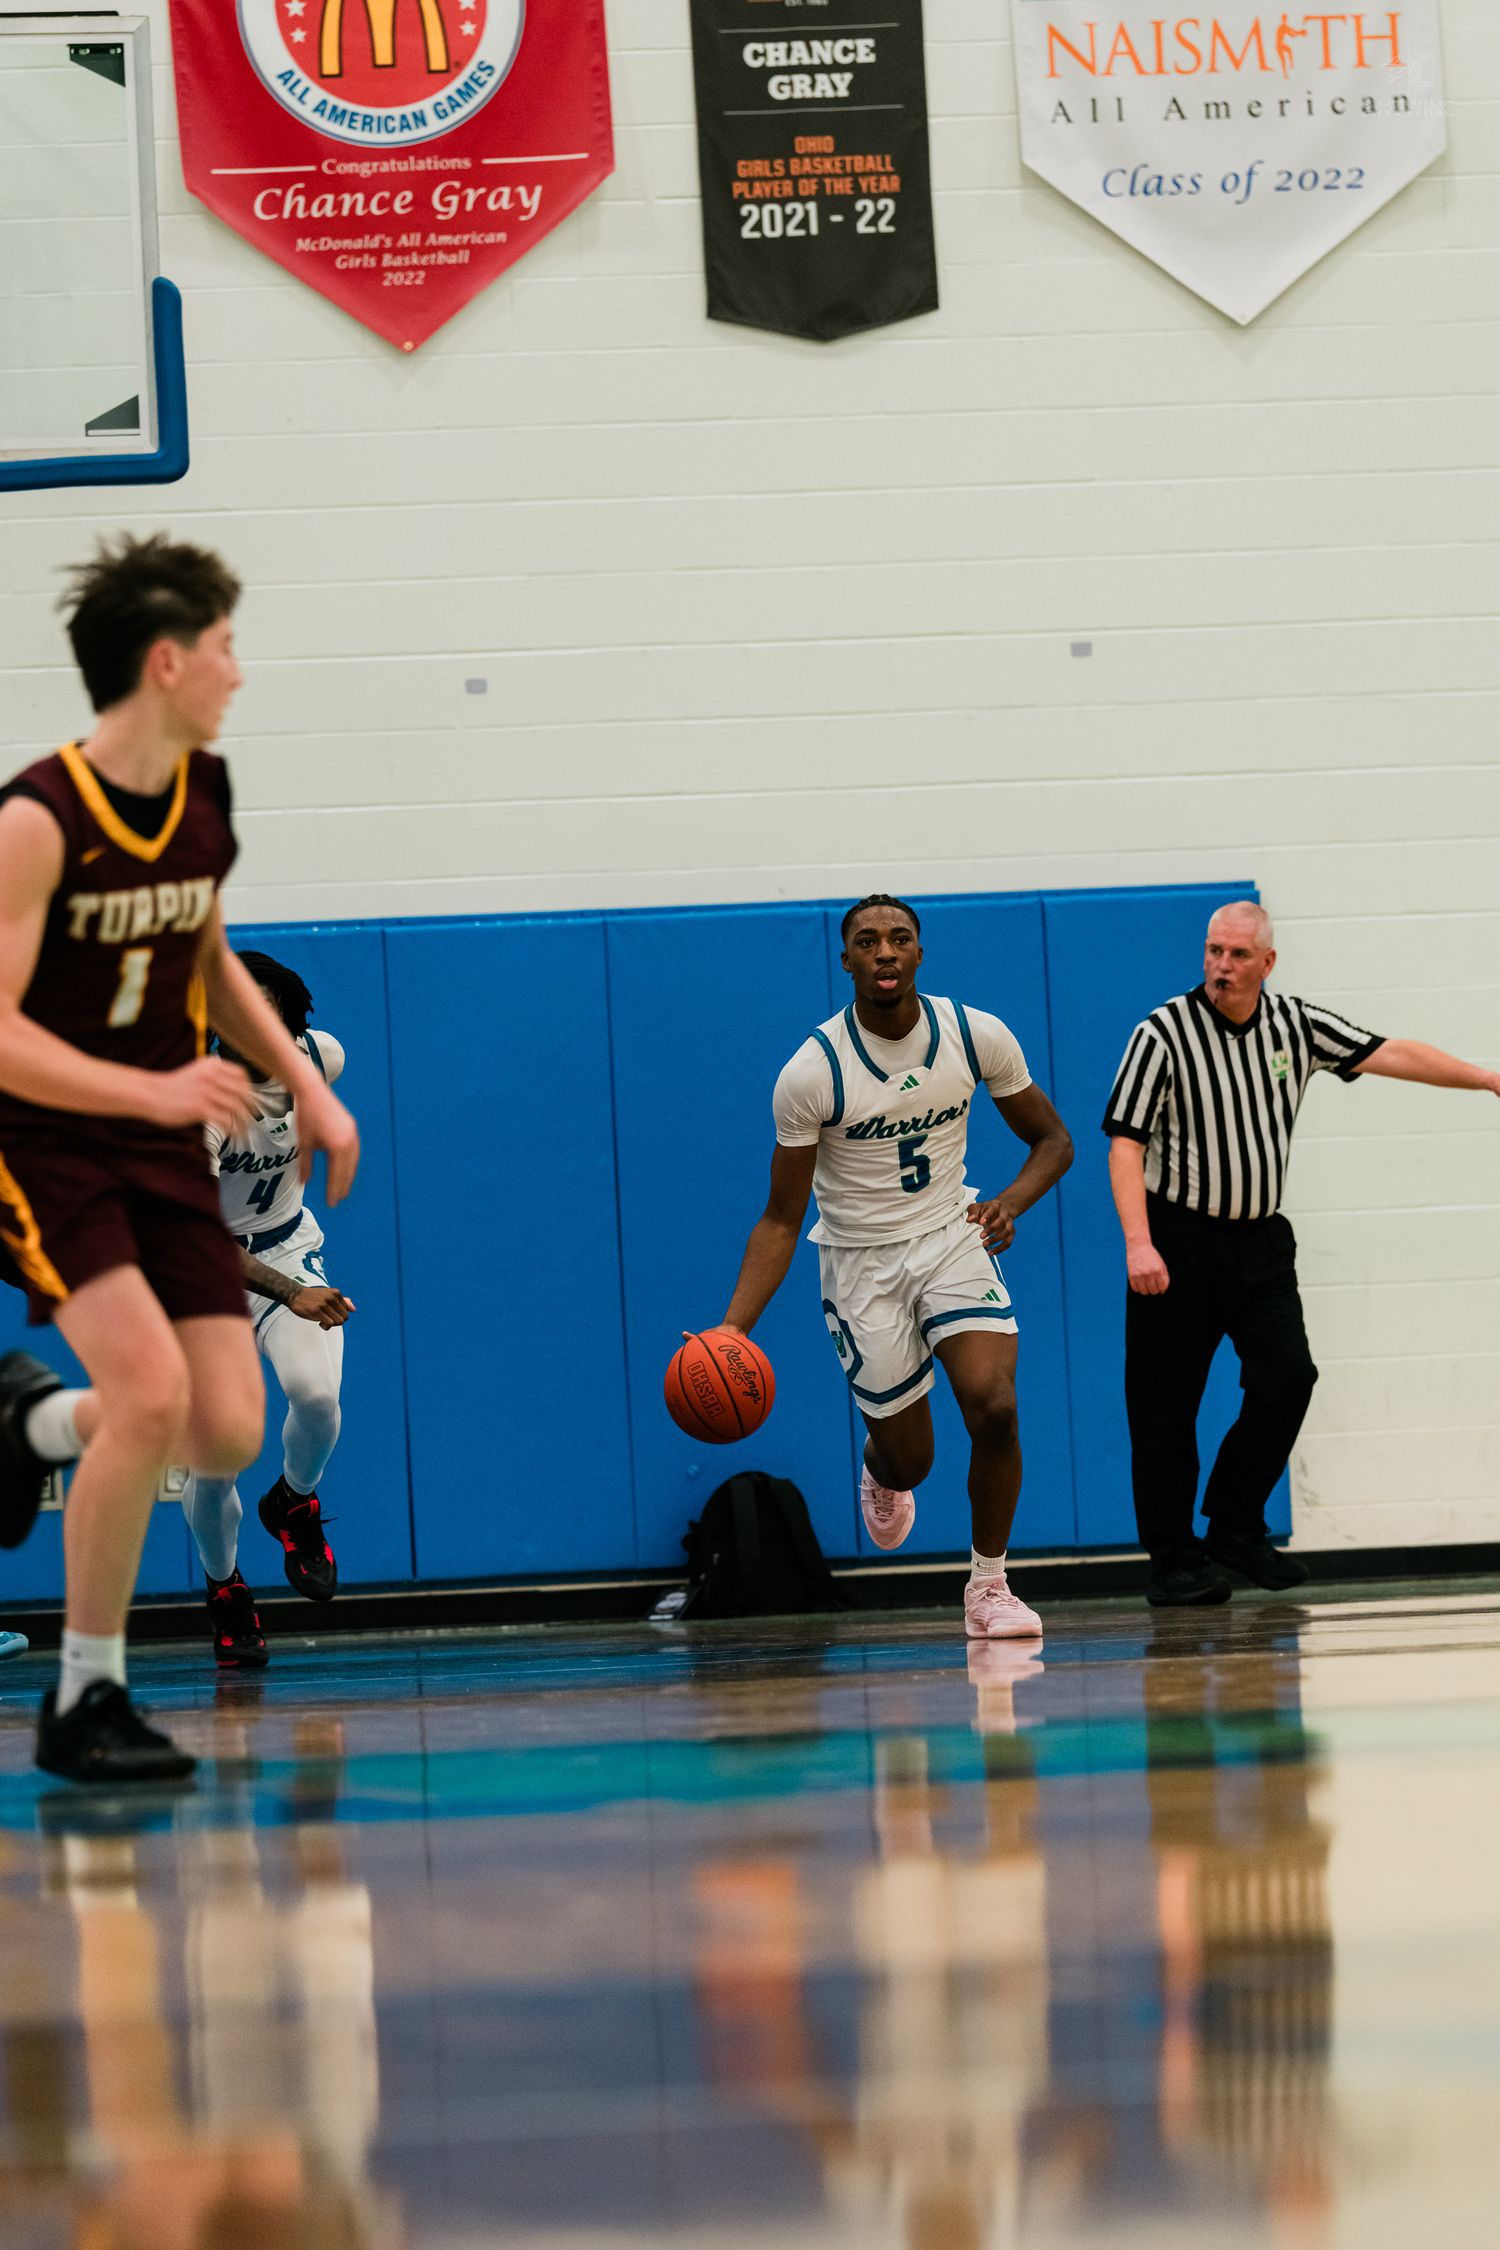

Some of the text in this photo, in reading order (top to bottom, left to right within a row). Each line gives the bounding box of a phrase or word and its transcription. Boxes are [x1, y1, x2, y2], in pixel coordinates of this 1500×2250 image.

[742, 38, 876, 68] CHANCE
[277, 60, 496, 133] ALL AMERICAN GAMES
[767, 72, 854, 101] GRAY
[1051, 97, 1124, 124] All
[1163, 90, 1414, 122] American
[794, 135, 835, 154] OHIO
[321, 155, 472, 178] Congratulations
[737, 154, 895, 178] GIRLS BASKETBALL
[1102, 159, 1366, 204] Class of 2022
[253, 181, 543, 221] Chance Gray
[732, 175, 901, 199] PLAYER OF THE YEAR
[740, 200, 819, 239] 2021
[855, 197, 896, 234] 22
[295, 231, 508, 252] McDonald's All American
[335, 250, 471, 270] Girls Basketball
[382, 270, 426, 287] 2022
[107, 947, 153, 1029] 1
[845, 1098, 968, 1140] Warriors
[897, 1133, 931, 1193] 5
[246, 1171, 285, 1215] 4
[717, 1344, 762, 1405] Rawlings
